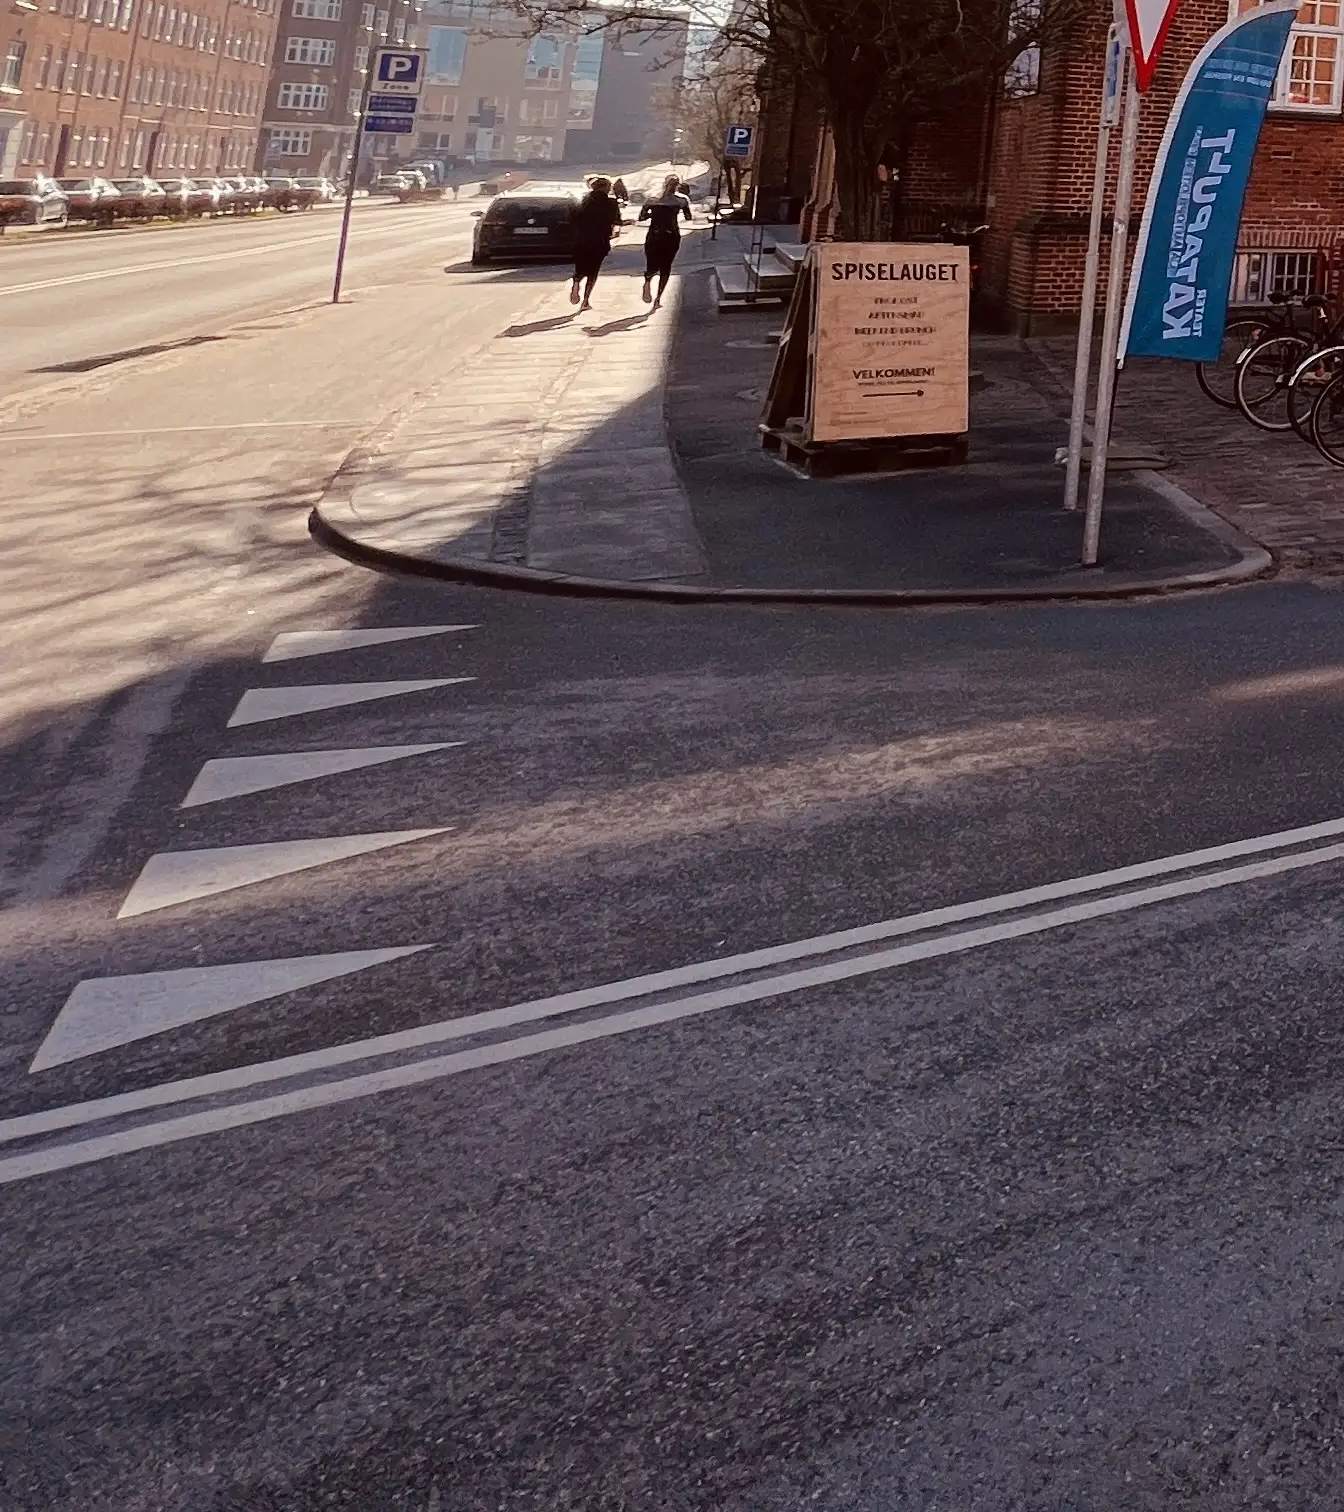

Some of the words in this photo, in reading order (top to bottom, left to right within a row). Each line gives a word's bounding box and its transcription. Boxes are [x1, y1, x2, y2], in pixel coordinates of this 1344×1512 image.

[388, 56, 412, 79] P
[733, 128, 748, 144] P
[831, 262, 959, 281] SPISELAUGET
